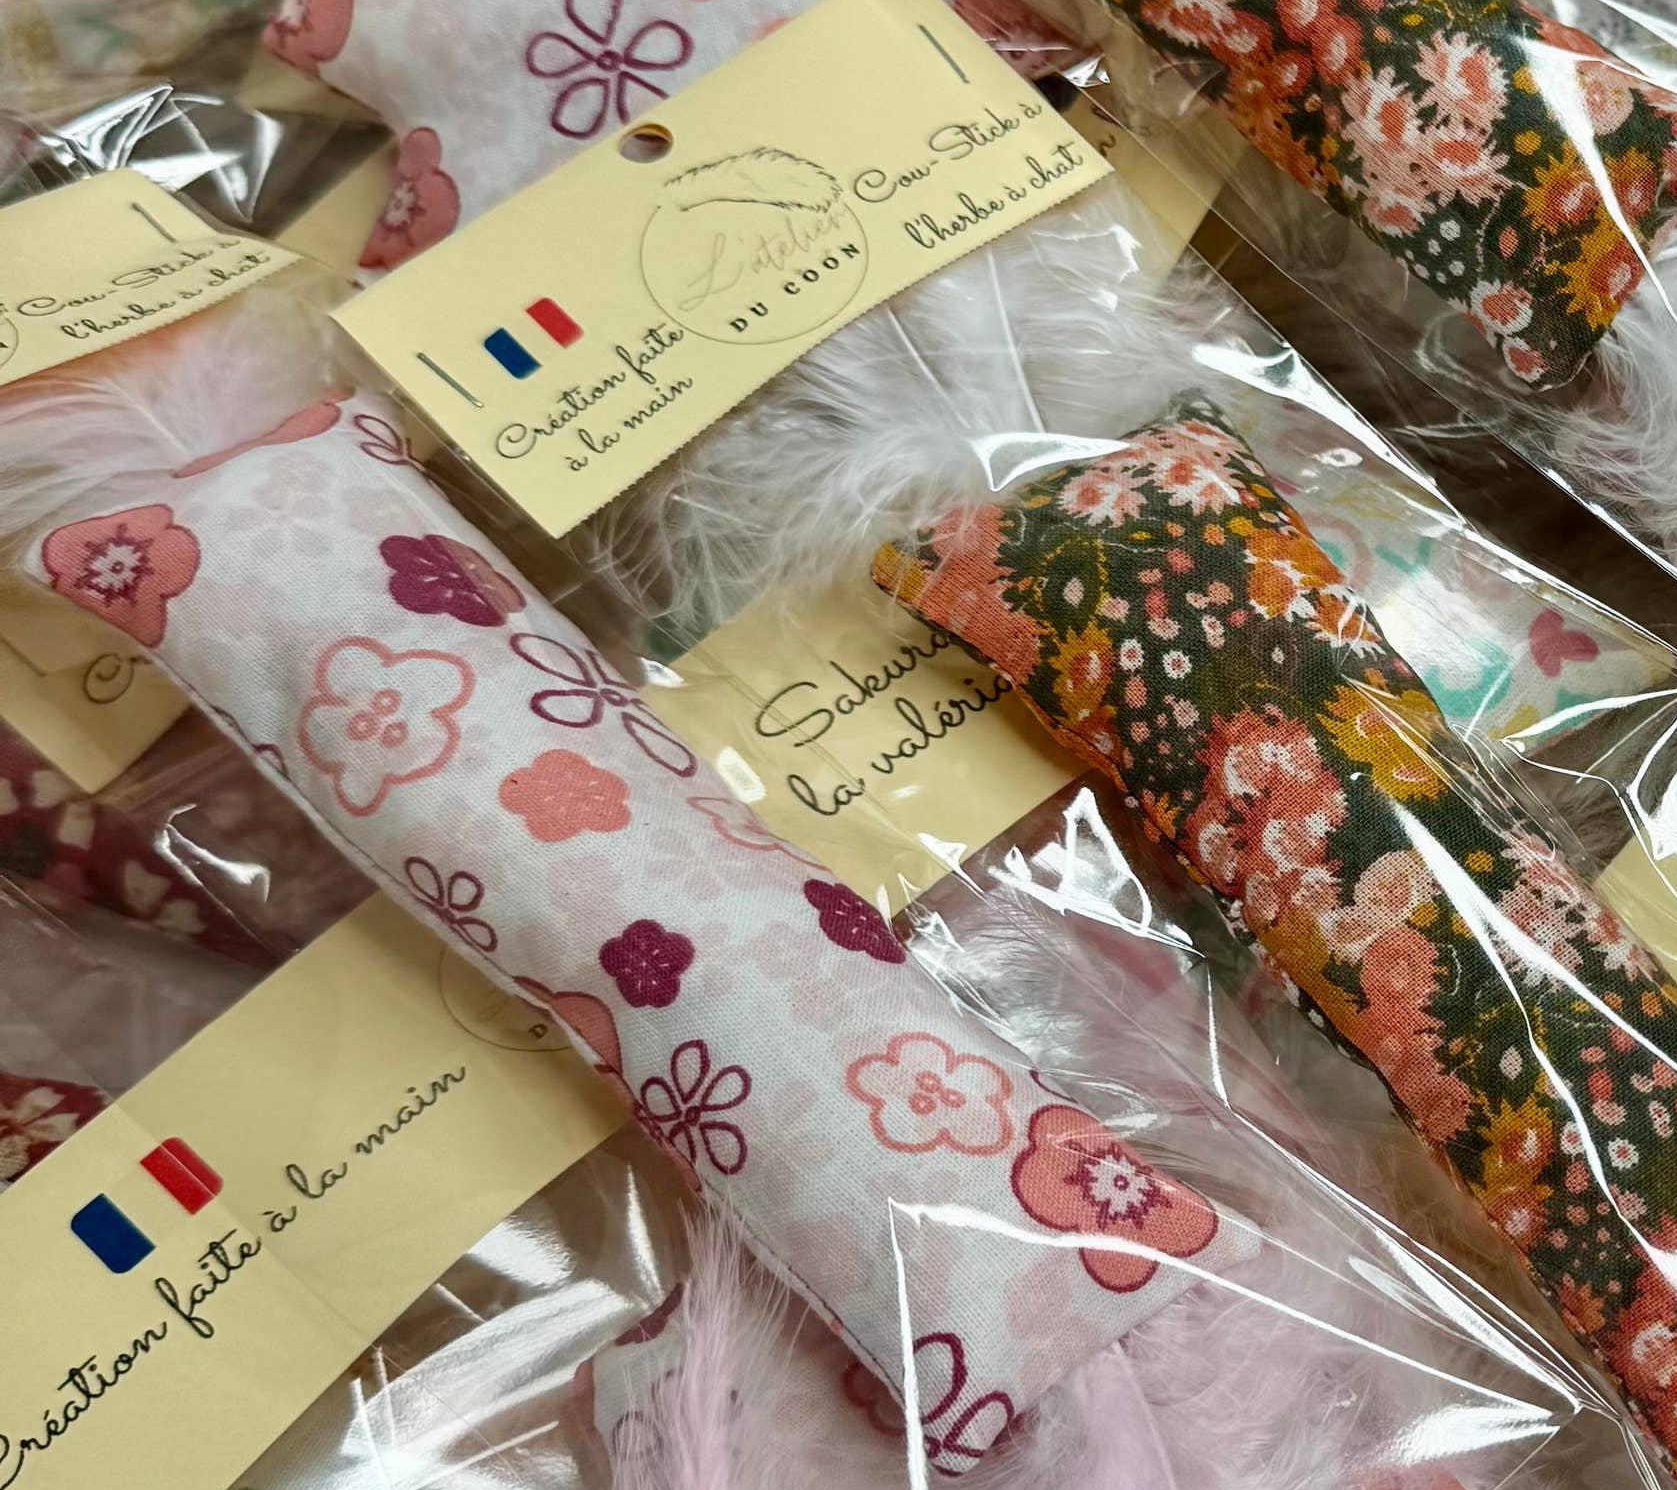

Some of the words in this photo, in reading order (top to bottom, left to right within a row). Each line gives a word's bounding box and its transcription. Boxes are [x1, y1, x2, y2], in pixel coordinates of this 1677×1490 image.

[852, 106, 1022, 204] Cou-Stick
[1019, 101, 1044, 120] à
[903, 193, 1005, 251] l'herbe
[1008, 184, 1028, 203] à
[1029, 140, 1086, 190] chat
[728, 300, 770, 335] DU
[494, 383, 627, 460] Création
[614, 322, 685, 386] faite
[563, 455, 590, 473] à
[577, 427, 621, 455] la
[622, 376, 694, 430] main
[786, 773, 867, 817] la
[154, 1228, 262, 1340] faite
[261, 1205, 299, 1234] à
[284, 1160, 349, 1200] la
[353, 1065, 467, 1156] main
